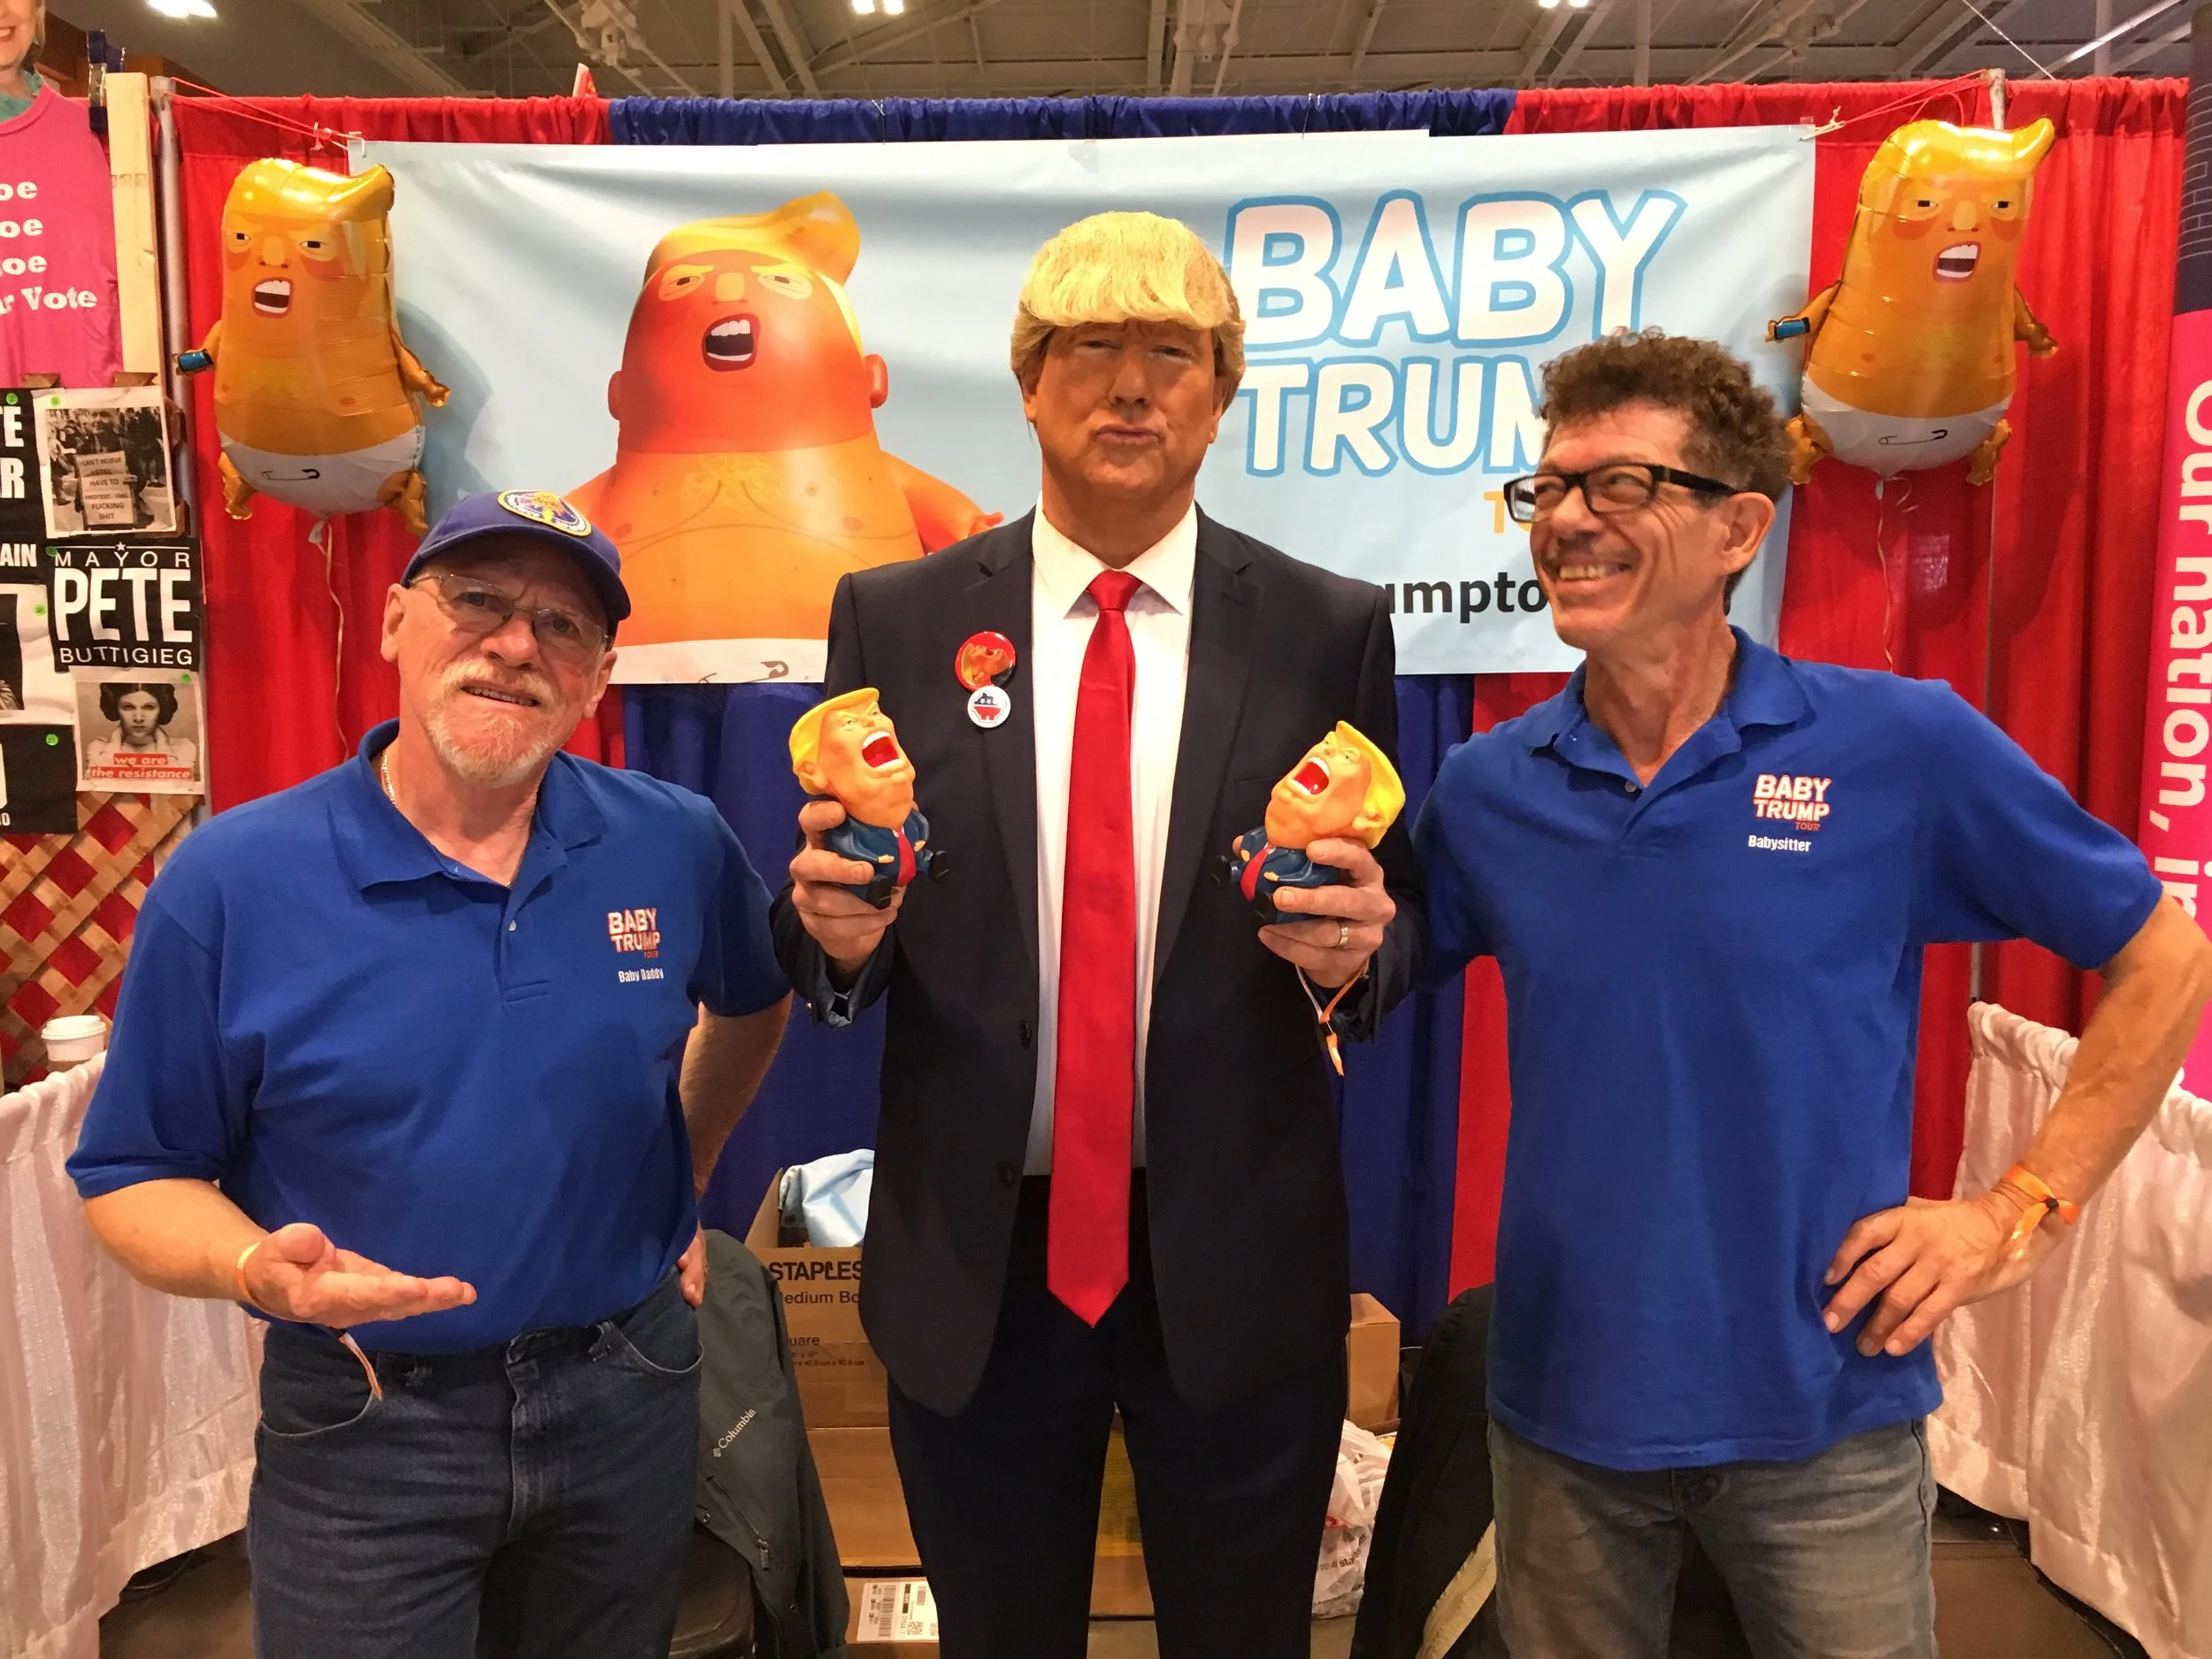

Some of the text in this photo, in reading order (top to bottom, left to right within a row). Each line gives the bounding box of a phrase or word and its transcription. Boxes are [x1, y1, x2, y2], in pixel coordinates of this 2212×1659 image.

[0, 255, 48, 277] oe
[1225, 189, 1687, 350] BABY
[21, 286, 97, 311] Vote
[0, 405, 25, 448] E
[55, 551, 190, 568] MAYOR
[54, 567, 193, 642] PETE
[59, 646, 193, 665] BUTTIGIEG
[2149, 557, 2212, 832] nation,
[91, 767, 190, 779] the resistance
[1754, 773, 1832, 803] BABY
[1753, 798, 1831, 823] TRUMP
[1794, 821, 1821, 832] TOUR
[1747, 834, 1812, 852] Babysitter
[607, 907, 657, 934] BABY
[611, 931, 661, 953] TRUMP
[618, 967, 664, 983] Baby Daddy
[769, 1260, 864, 1281] STAPLES
[718, 1409, 757, 1448] Columbia
